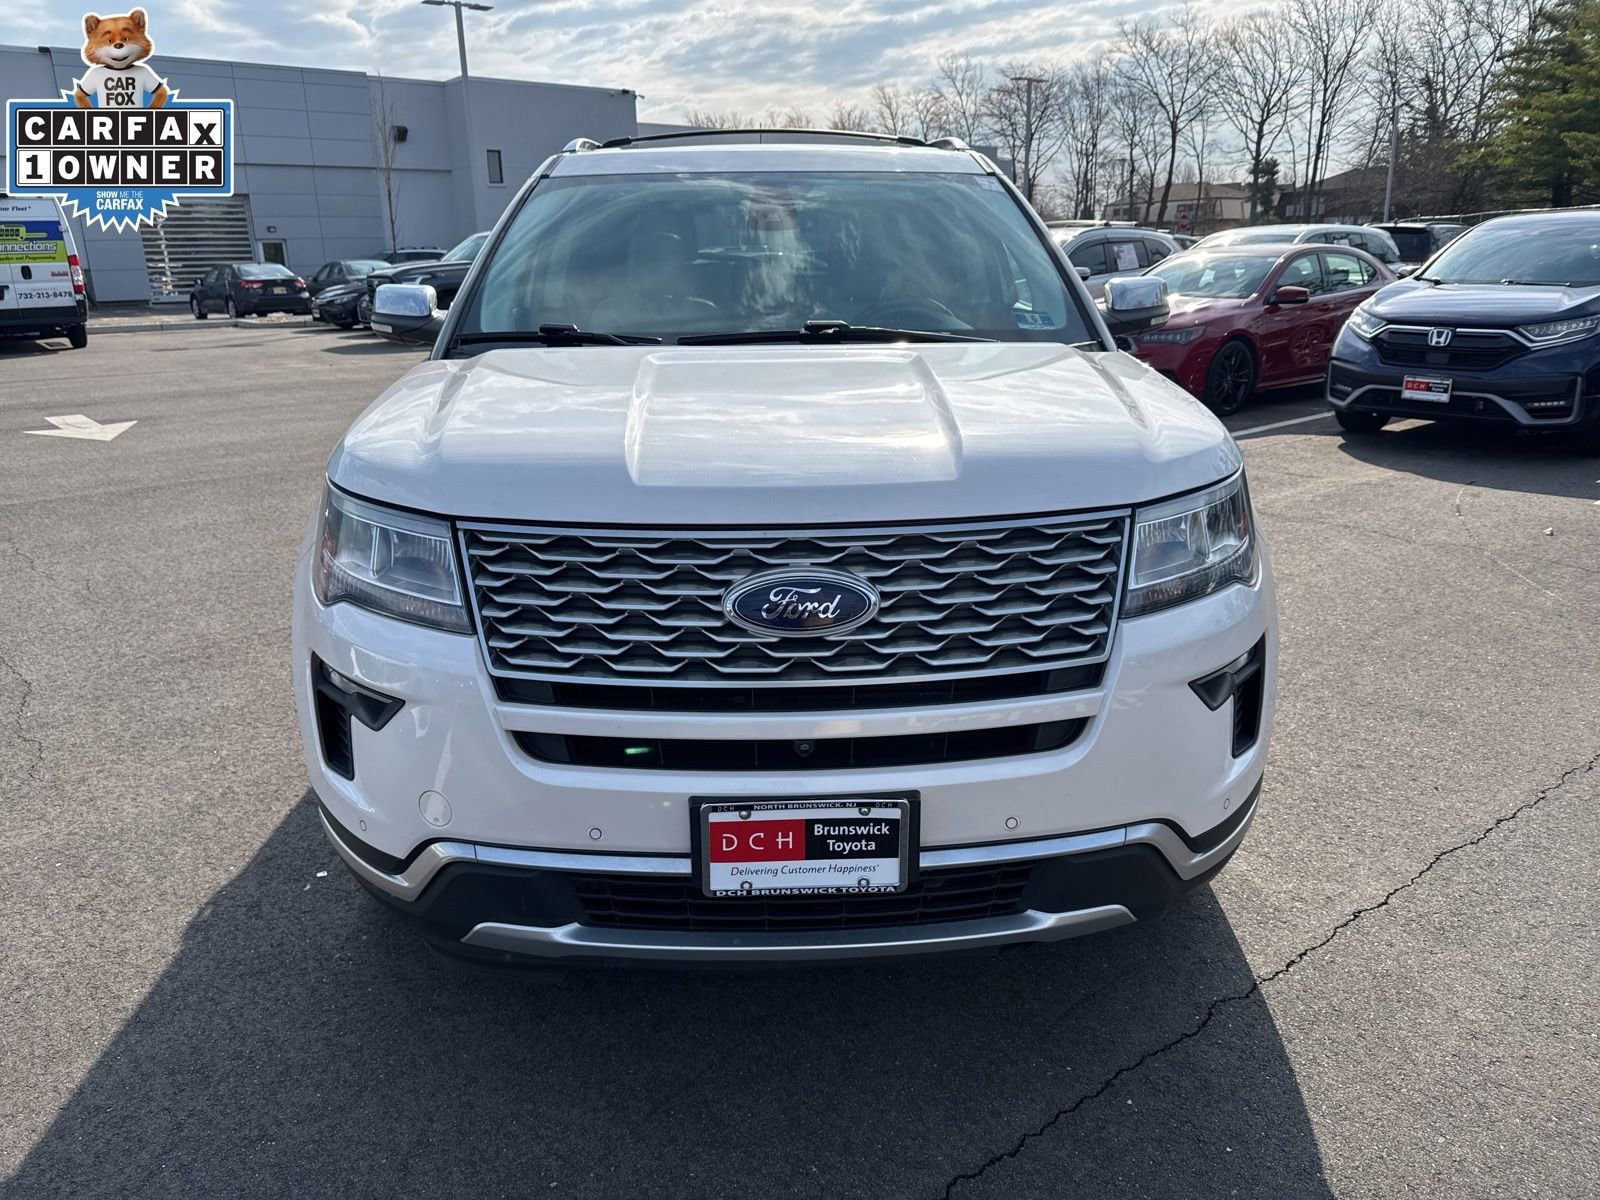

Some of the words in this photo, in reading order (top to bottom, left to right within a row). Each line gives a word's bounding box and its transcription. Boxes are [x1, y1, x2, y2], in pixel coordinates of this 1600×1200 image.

[761, 586, 842, 620] Ford
[814, 823, 890, 836] Brunswick
[827, 839, 876, 854] Toyota
[730, 866, 779, 877] Delivering
[780, 864, 826, 875] Customer
[716, 889, 747, 897] DCH
[751, 886, 837, 895] BRUNSWICK
